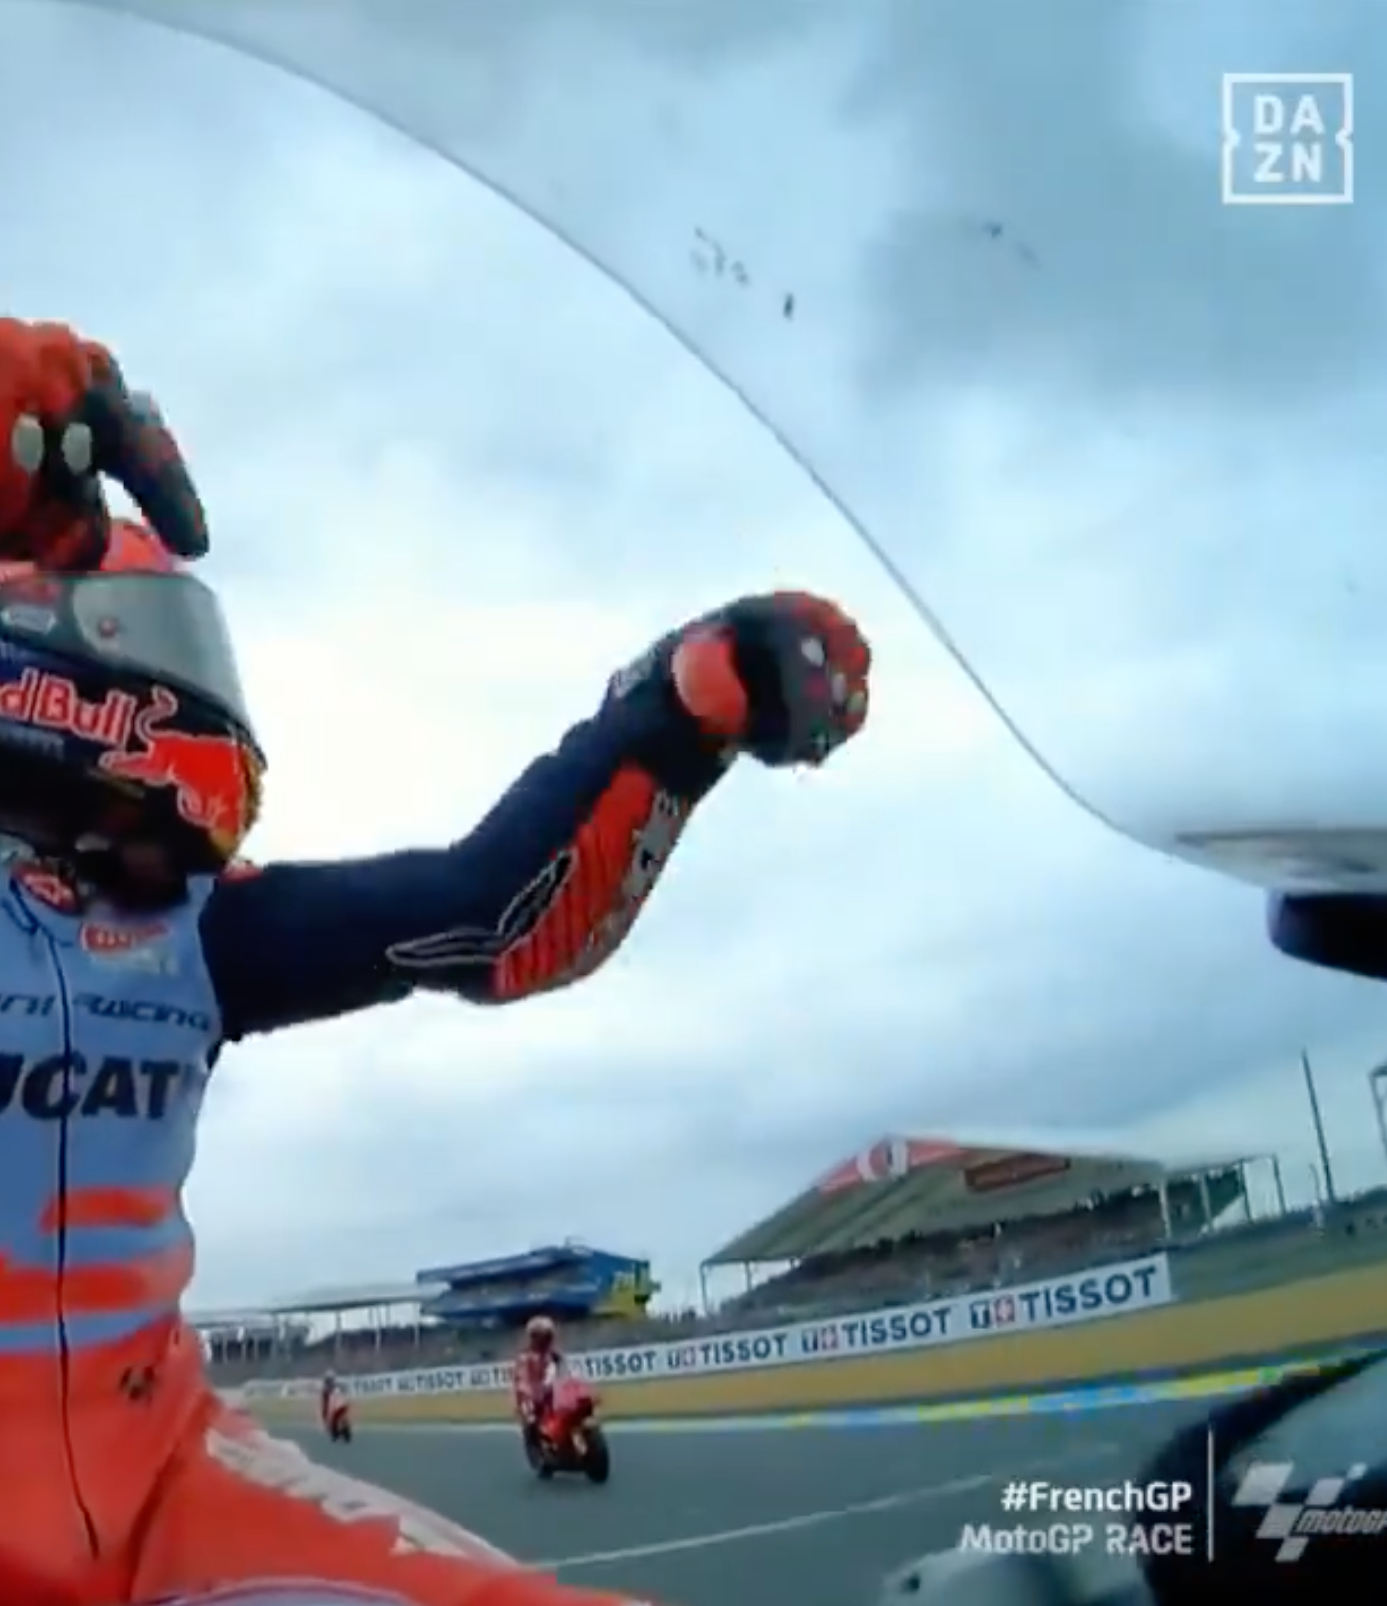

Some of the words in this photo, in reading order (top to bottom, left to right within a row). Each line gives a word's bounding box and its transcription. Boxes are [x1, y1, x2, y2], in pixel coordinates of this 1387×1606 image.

[32, 672, 138, 750] Bull
[1018, 1264, 1157, 1323] TISSOT
[842, 1307, 952, 1347] TISSOT
[585, 1350, 657, 1378] TISSOT
[702, 1331, 789, 1366] TISSOT
